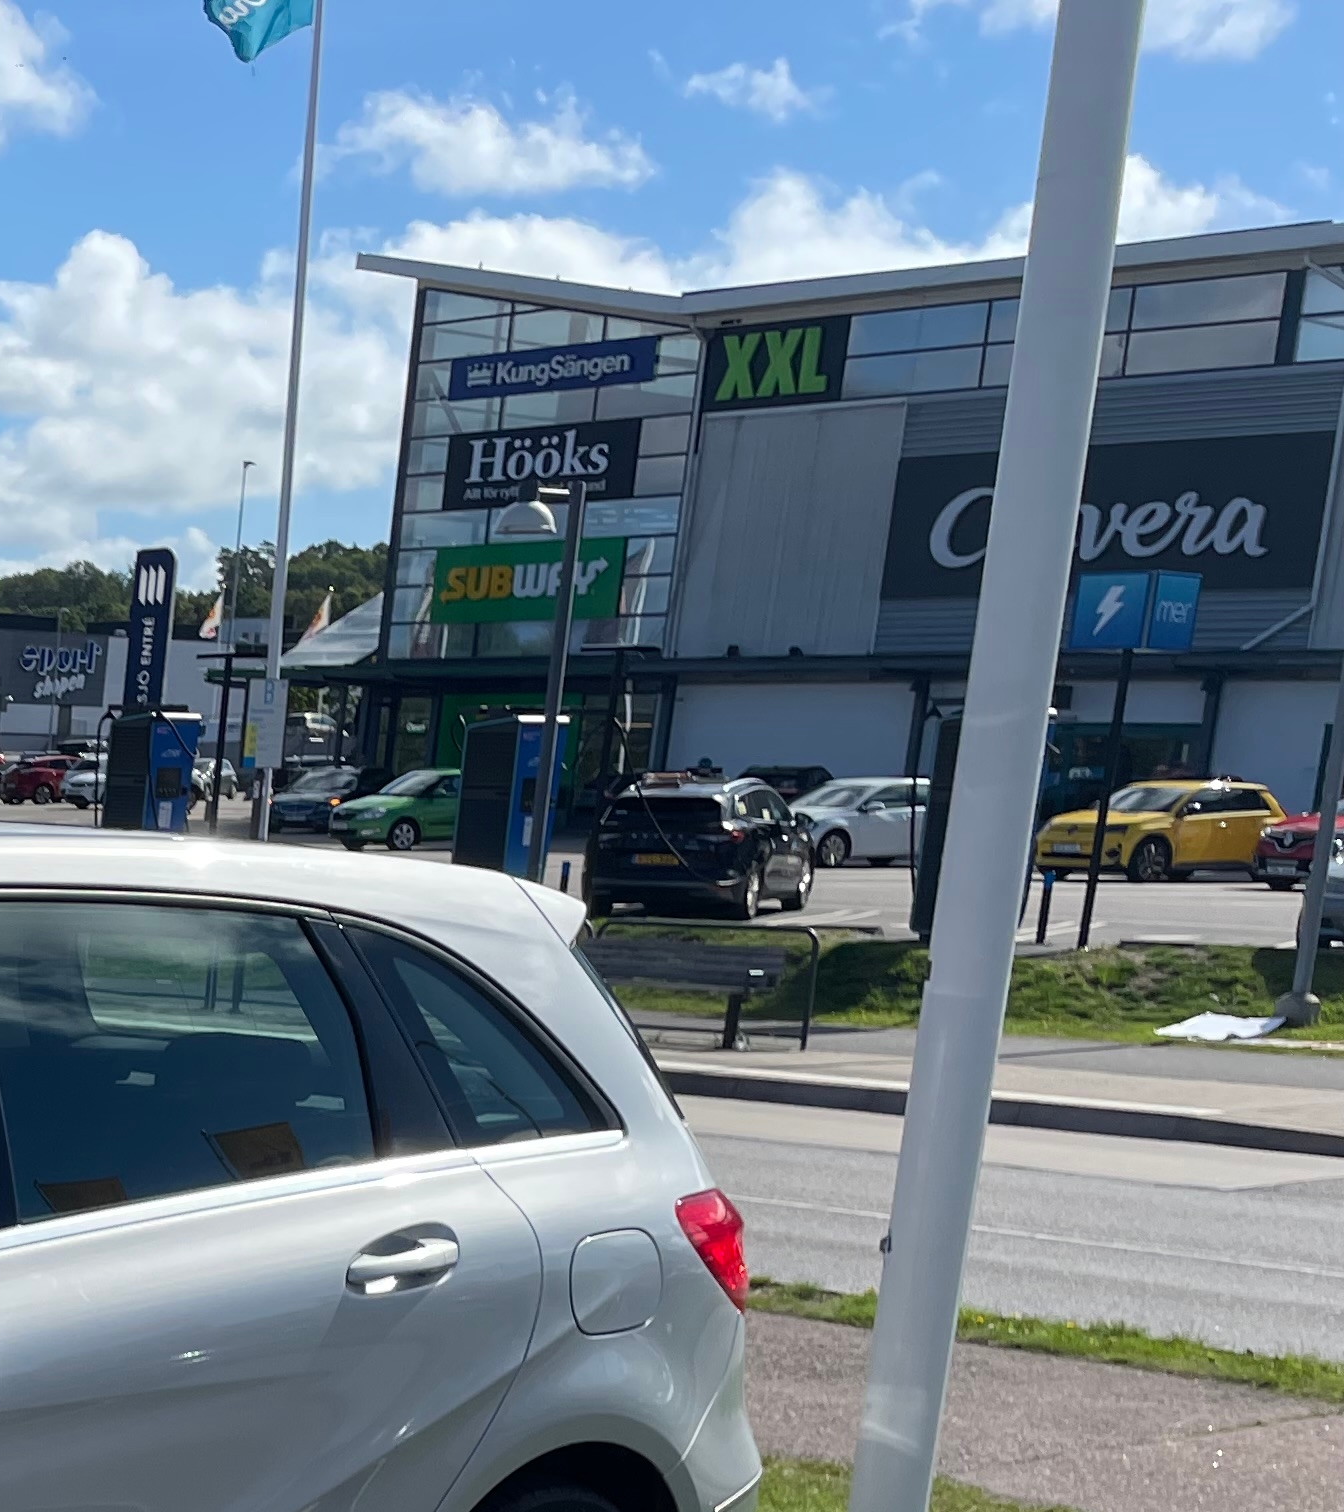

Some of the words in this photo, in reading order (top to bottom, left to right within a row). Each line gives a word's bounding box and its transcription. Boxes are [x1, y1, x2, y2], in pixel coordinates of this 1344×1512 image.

[495, 353, 631, 387] KungSängen
[715, 326, 827, 400] XXL
[464, 428, 609, 484] Hööks
[929, 486, 1269, 569] Cvera
[1156, 599, 1193, 624] mer
